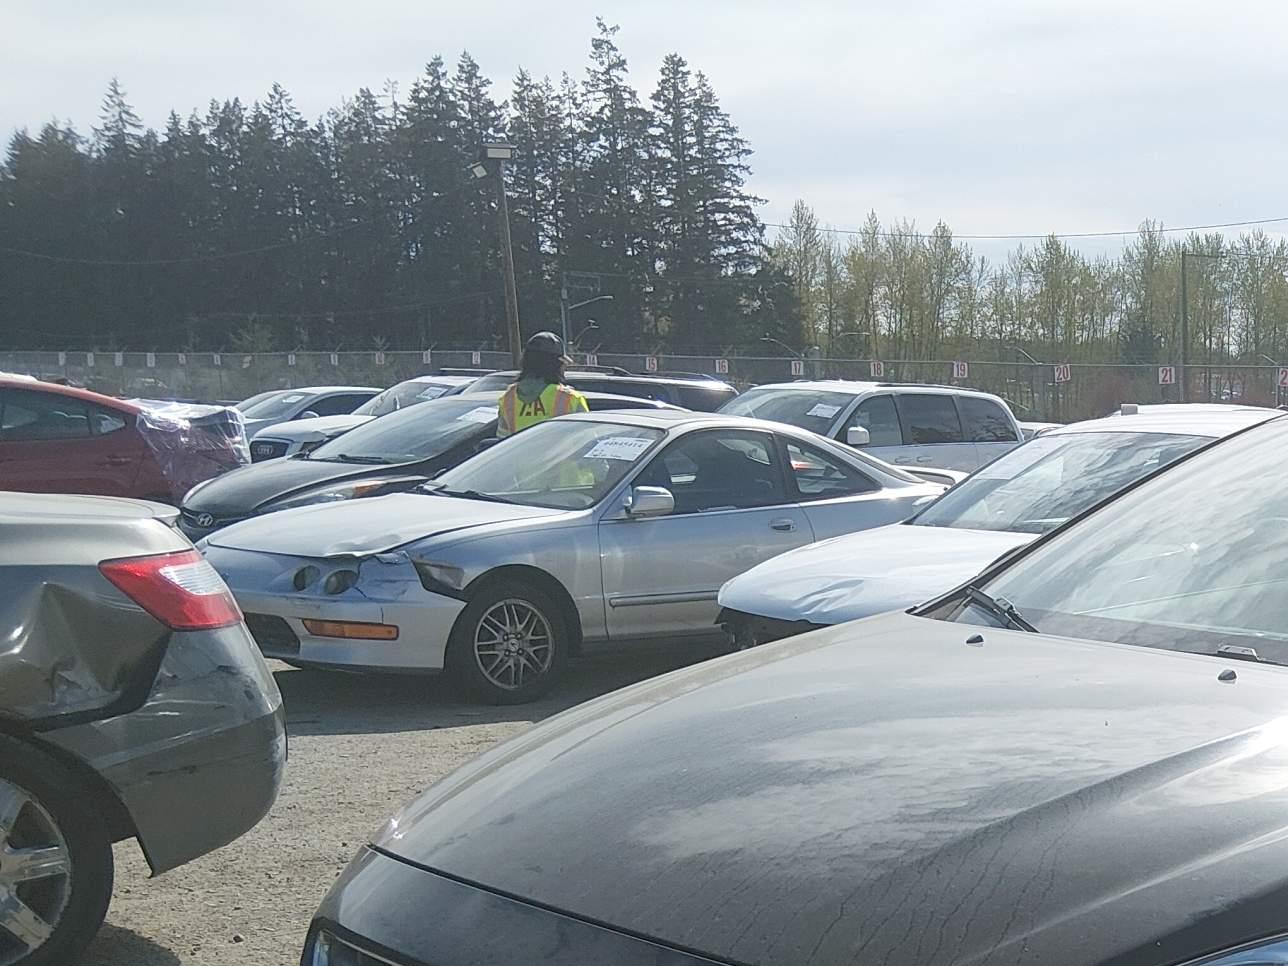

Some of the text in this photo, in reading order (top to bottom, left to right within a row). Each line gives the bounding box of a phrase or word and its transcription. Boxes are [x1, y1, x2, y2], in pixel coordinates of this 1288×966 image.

[647, 357, 656, 370] 15
[717, 359, 727, 373] 16
[793, 361, 803, 375] 17
[872, 363, 882, 376] 18
[955, 363, 967, 377] 19
[1056, 366, 1070, 381] 20
[1161, 368, 1173, 383] 21
